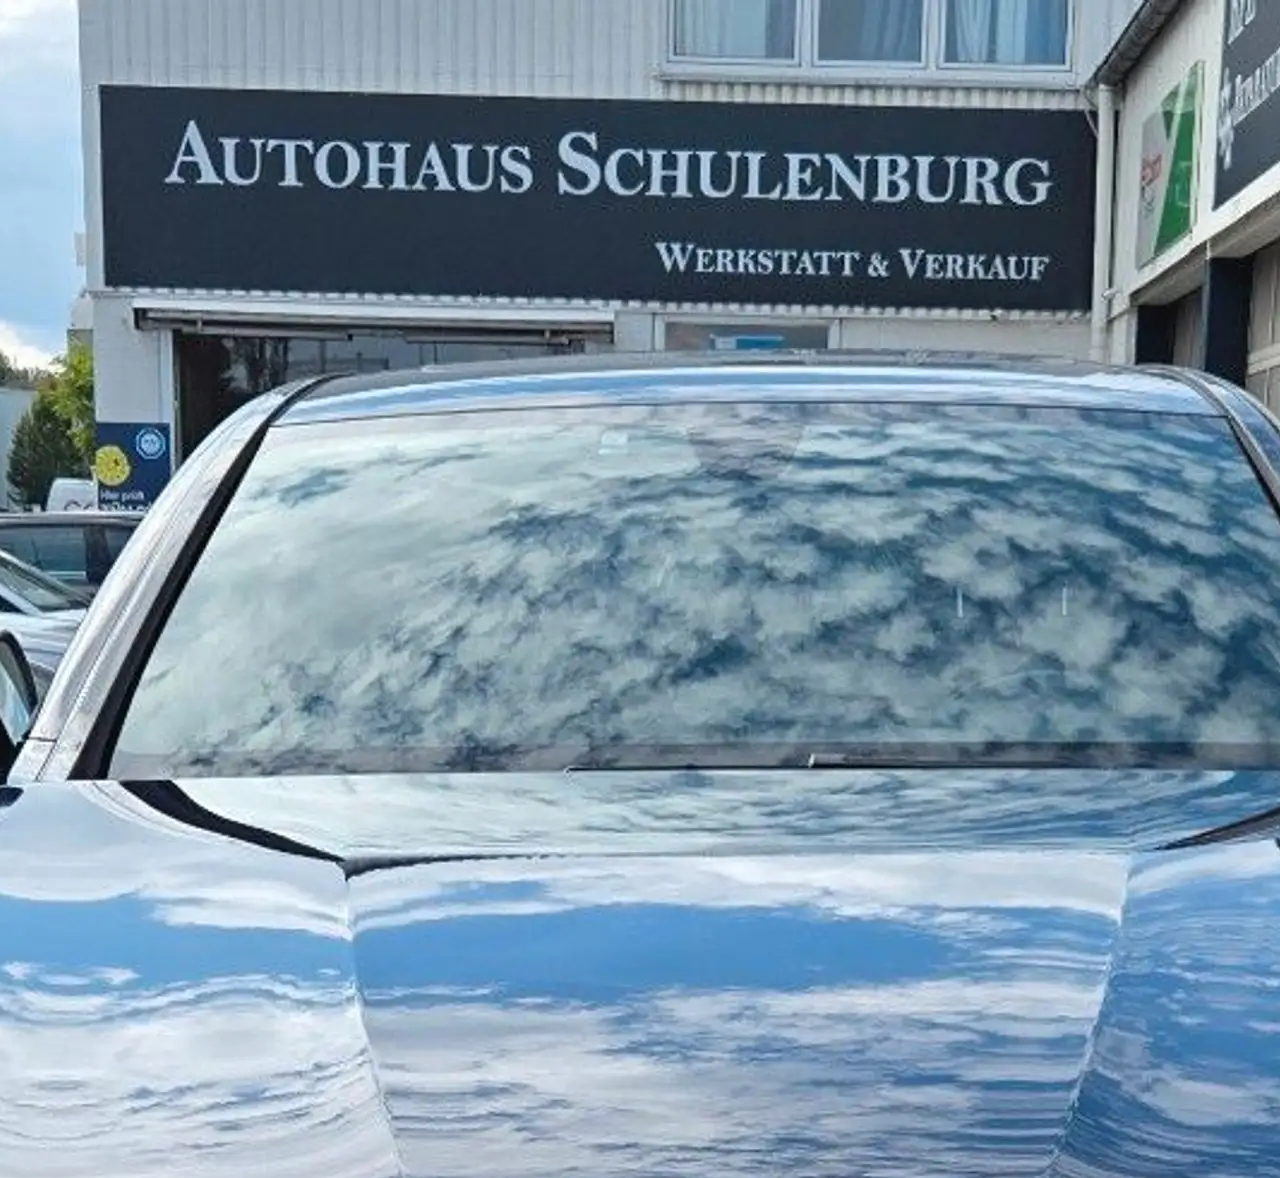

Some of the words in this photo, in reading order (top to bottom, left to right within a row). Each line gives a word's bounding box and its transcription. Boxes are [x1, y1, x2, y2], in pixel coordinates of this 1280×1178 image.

[164, 119, 533, 194] AUTOHAUS
[557, 131, 1052, 206] SCHULENBURG
[654, 241, 860, 278] WERKSTATT
[867, 252, 889, 277] &
[898, 248, 1050, 281] VERKAUF
